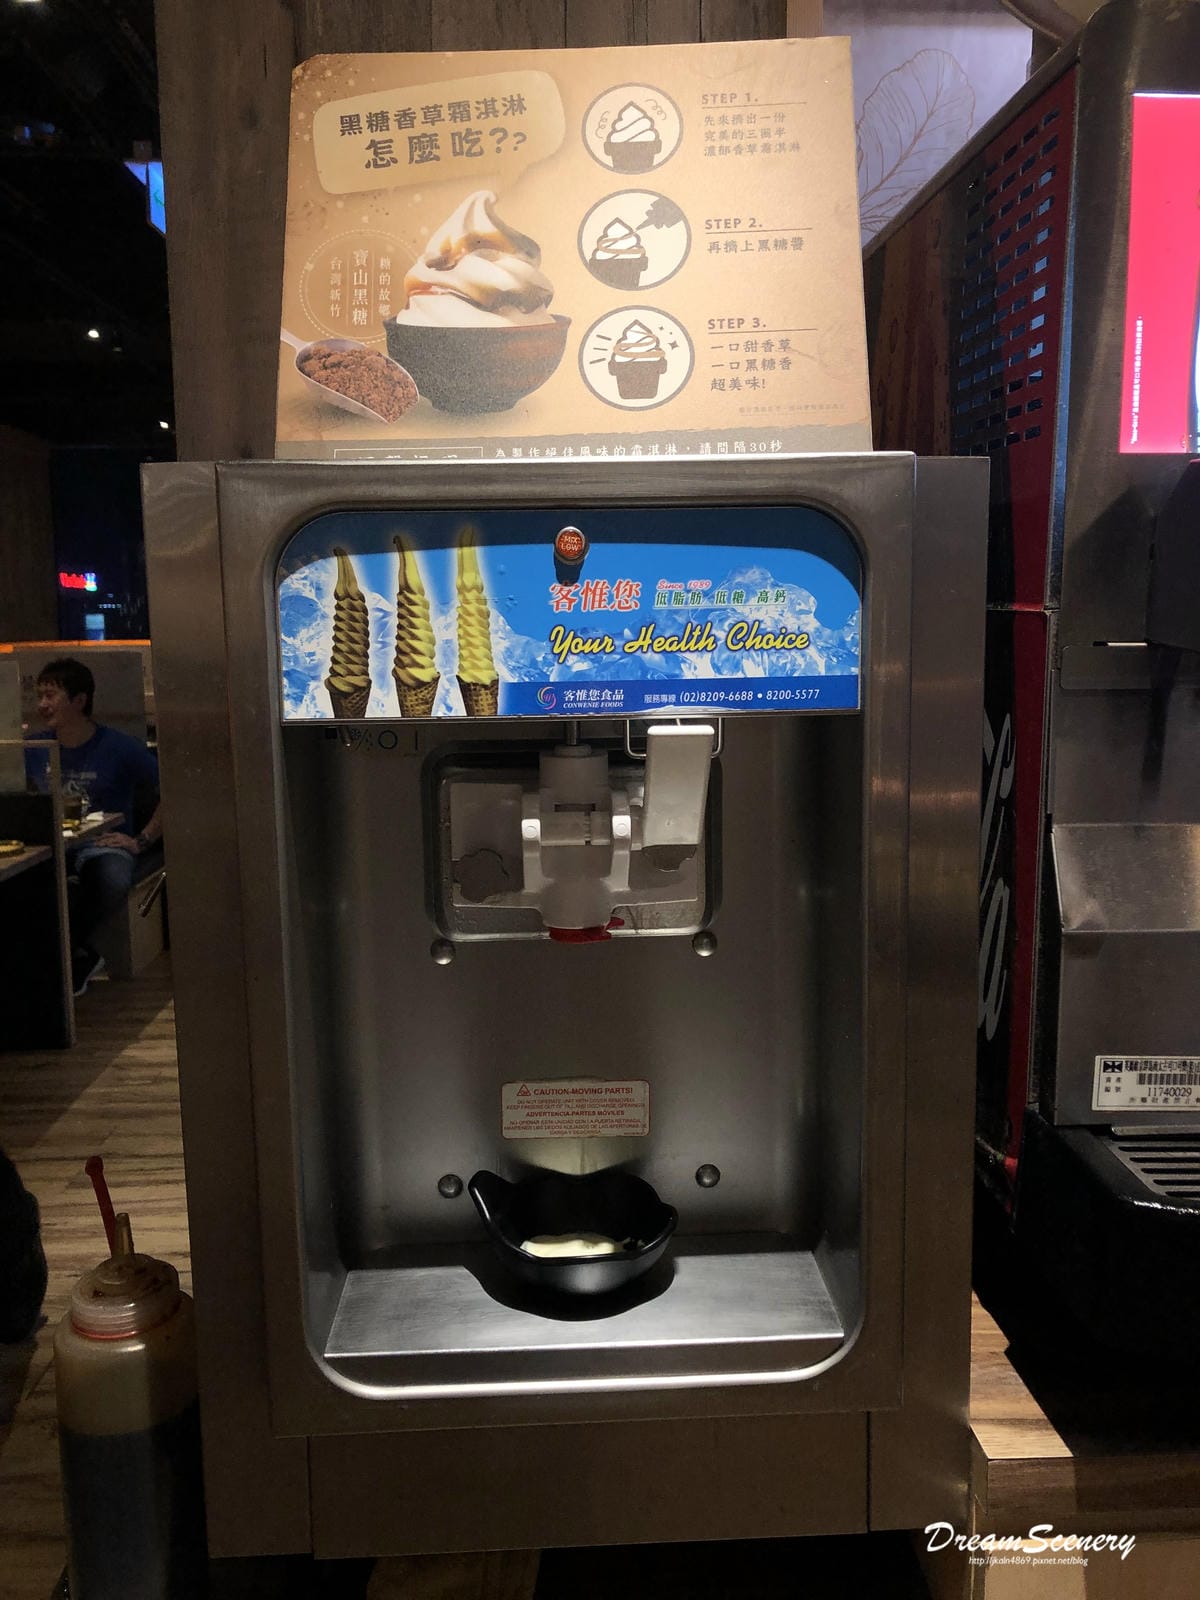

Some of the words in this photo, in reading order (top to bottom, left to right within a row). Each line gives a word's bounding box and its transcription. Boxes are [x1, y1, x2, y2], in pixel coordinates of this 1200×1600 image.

[702, 93, 737, 105] STEP
[745, 92, 758, 103] 1.
[339, 93, 527, 137] 黑糖香草霜淇淋
[705, 218, 741, 230] STEP
[749, 217, 763, 228] 2.
[708, 318, 745, 330] STEP
[752, 317, 767, 328] 3.
[710, 338, 792, 353] 一口甜香草
[711, 357, 792, 372] 一口黑糖香
[657, 579, 683, 590] Since
[550, 579, 641, 612] 客惟您
[656, 590, 702, 606] 低脂肪
[715, 589, 745, 604] 低糖
[757, 588, 787, 604] 高鈣
[550, 624, 614, 663] Your
[624, 621, 716, 653] Health
[726, 620, 809, 650] Choice
[563, 689, 624, 701] 客惟您食品
[680, 690, 753, 703] (02)8209-6688
[766, 688, 820, 701] 8200-5577
[599, 701, 624, 709] FOODS
[1147, 1087, 1192, 1097] 11740029
